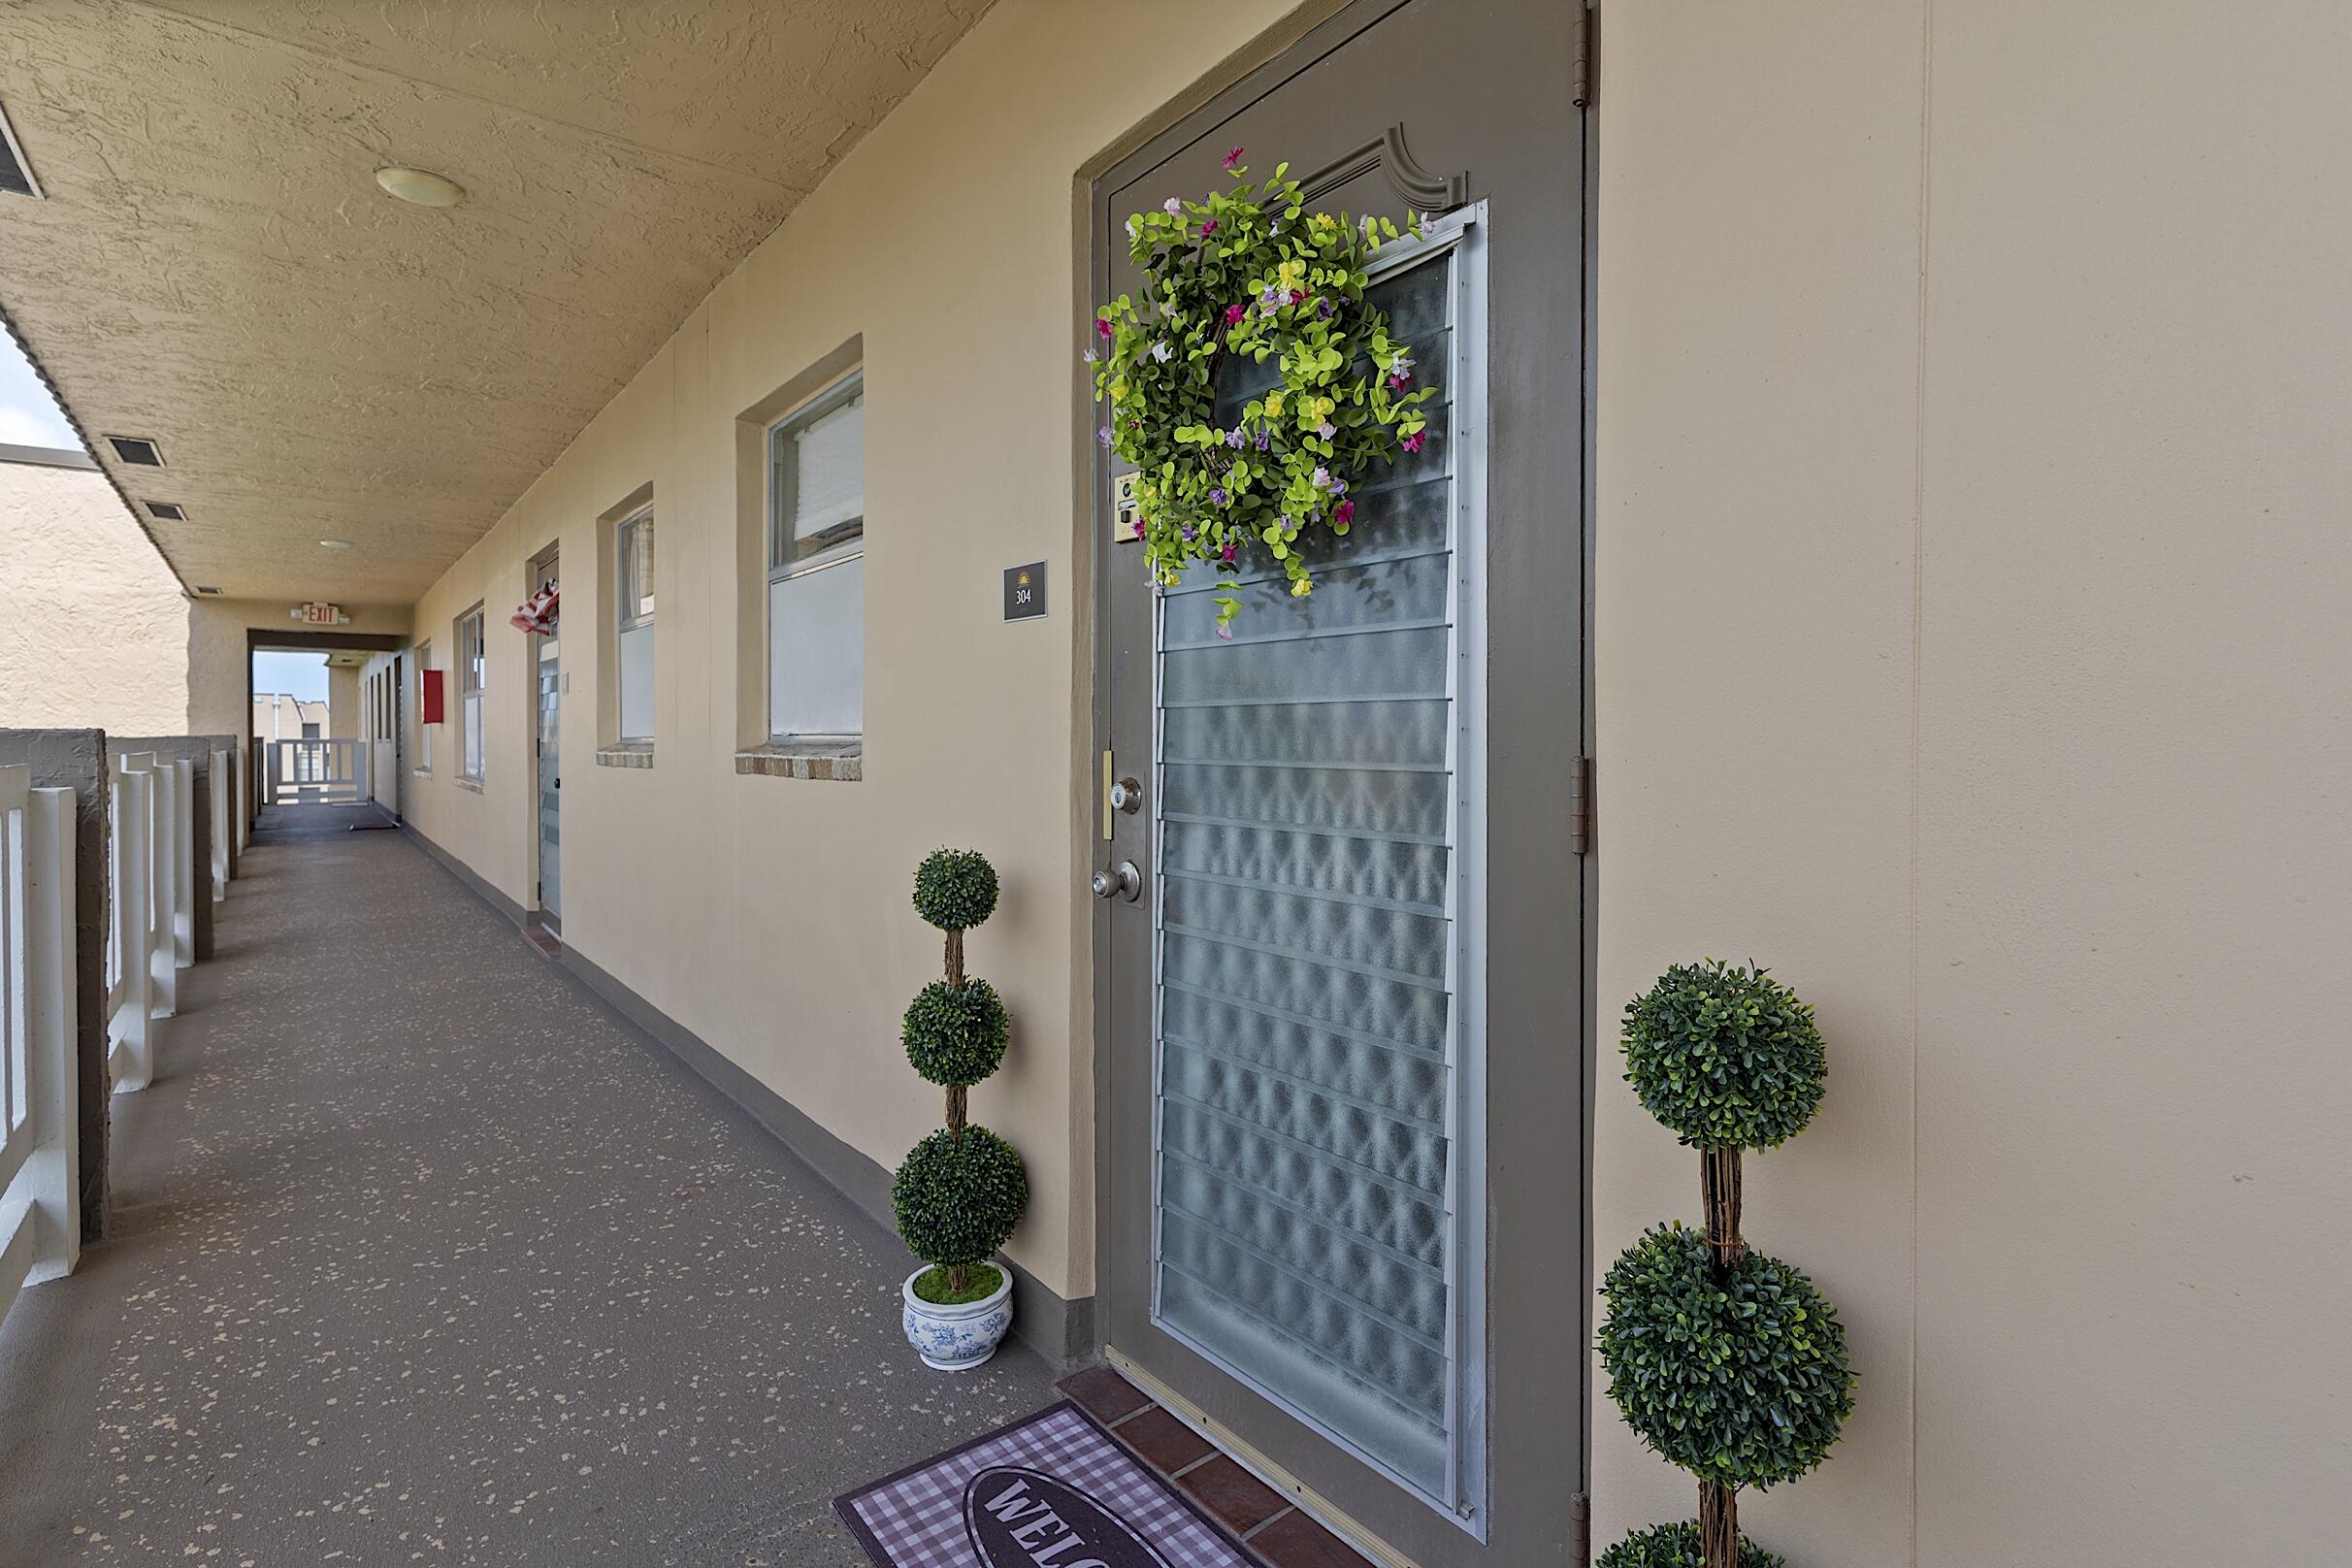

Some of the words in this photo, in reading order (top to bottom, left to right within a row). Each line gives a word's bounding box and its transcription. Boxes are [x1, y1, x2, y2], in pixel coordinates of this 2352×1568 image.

[1016, 589, 1031, 604] 304
[309, 605, 335, 623] EXIT
[984, 1478, 1110, 1568] WEL
